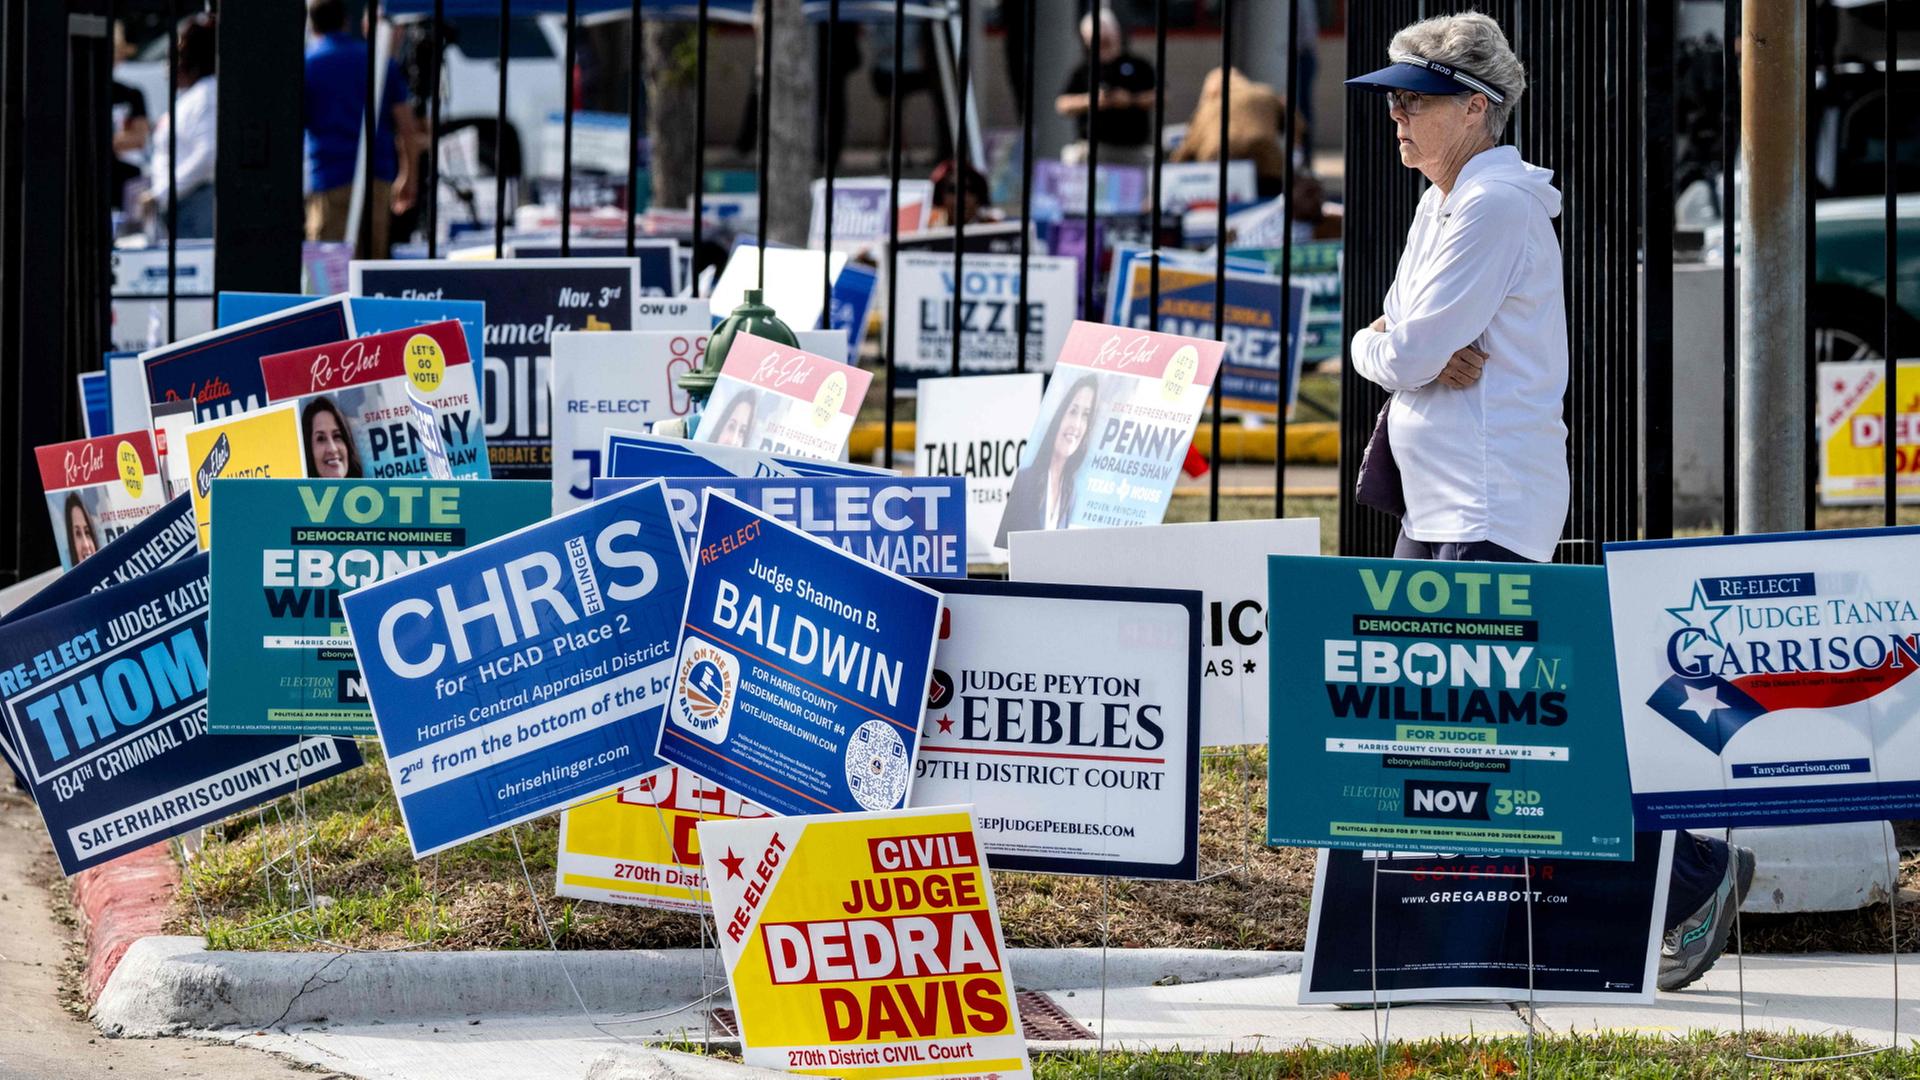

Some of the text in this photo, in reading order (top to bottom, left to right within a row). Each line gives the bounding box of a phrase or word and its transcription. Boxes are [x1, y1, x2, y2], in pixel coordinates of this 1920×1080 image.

[1430, 62, 1452, 76] IZOD
[558, 287, 593, 308] Nov.
[599, 286, 622, 307] 3rd
[668, 304, 688, 317] UP
[485, 314, 572, 344] amel
[920, 299, 1044, 334] LIZZIE
[310, 342, 381, 392] Re-Elect
[411, 346, 435, 356] LET'S
[418, 359, 432, 369] GO
[1091, 335, 1160, 369] Re-Elect
[413, 372, 440, 384] VOTE!
[752, 351, 816, 388] Re-Elect
[364, 394, 470, 423] STATE REPNTATIVE
[567, 399, 650, 413] RE-ELECT
[1134, 404, 1193, 425] REPRESENTATIVE
[368, 410, 471, 462] PENNY
[1098, 417, 1187, 462] PENNY
[64, 443, 104, 487] Re-Elect
[122, 452, 136, 462] LET'S
[127, 466, 136, 476] GO
[374, 448, 477, 479] MORALE HAW
[490, 448, 537, 463] ROBATE
[1091, 455, 1174, 482] MORALES SHAW
[125, 479, 142, 490] VOTE!
[972, 488, 1003, 504] TEXAS
[1086, 477, 1163, 504] TEXAS HOUSE
[298, 486, 461, 525] VOTE
[664, 484, 951, 532] RELECT
[296, 530, 452, 542] DEMOCRATIC NOMINEE
[700, 518, 762, 566] RE-ELECT
[868, 535, 958, 574] MARIE
[569, 537, 602, 616] EHLINGER
[1358, 568, 1532, 616] VOTE
[1719, 577, 1801, 597] RE-ELECT
[378, 519, 660, 680] CHRIS
[748, 558, 880, 633] Judge Shannon B.
[1359, 619, 1524, 637] DEMOCRATIC NOMINEE
[1738, 599, 1919, 635] JUDGE TANYA
[1, 599, 167, 697] RE-ELECT JUDGE
[434, 614, 631, 700] for HCAD Place 2
[712, 578, 904, 708] BALDWIN
[1666, 626, 1920, 679] GARRISON
[1324, 638, 1568, 690] EBONY N.
[26, 629, 208, 762] THOM
[280, 676, 335, 688] ELECTION
[312, 688, 335, 699] DAY
[416, 639, 671, 742] Harris Central Appraisal District
[679, 648, 732, 719] BACK ON THE BENCH
[752, 666, 838, 714] FOR HARRIS COUNTY
[960, 669, 1141, 698] JUDGE PEYTON
[680, 696, 719, 730] BALDWIN
[740, 679, 846, 737] MISDEMEANOR COURT #4
[1325, 683, 1569, 727] WILLIAMS
[399, 678, 647, 786] 2nd from the bottom of the
[740, 700, 838, 754] VOTEJUDGEBALDWIN.COM
[960, 695, 1165, 751] EEBLES
[1406, 729, 1487, 742] FOR JUDGE
[52, 728, 183, 803] 184TH CRIMINAL
[1358, 743, 1390, 752] HARRIS
[1392, 744, 1426, 753] COUNTY
[1428, 746, 1452, 754] CIVIL
[1454, 747, 1482, 755] COURT
[1485, 748, 1496, 756] AT
[1386, 757, 1506, 772] ebonywilliamsforjudge.com
[497, 743, 631, 801] chrisehlinger.com
[916, 760, 1165, 791] 97TH DISTRICT COURT
[1751, 762, 1851, 776] TanyaGarrison.com
[78, 741, 332, 852] SAFERHARRISCOUNTY.COM
[1342, 785, 1401, 800] ELECTION
[1377, 800, 1401, 813] DAY
[1413, 788, 1479, 815] NOV
[1494, 788, 1541, 816] 3RD
[978, 817, 1136, 838] EEPJUDGEPEEBLES.COM
[1515, 807, 1545, 817] 2026
[1502, 832, 1522, 840] JUDGE
[877, 835, 972, 870] CIVIL
[614, 863, 661, 884] 270th
[726, 832, 788, 944] RE-ELECT
[1411, 864, 1555, 882] GOVERNOR
[842, 872, 981, 914] JUDGE
[764, 912, 1000, 984] DEDRA
[819, 977, 1009, 1043] DAVIS
[788, 1042, 974, 1068] 270th District CIVIL Court
